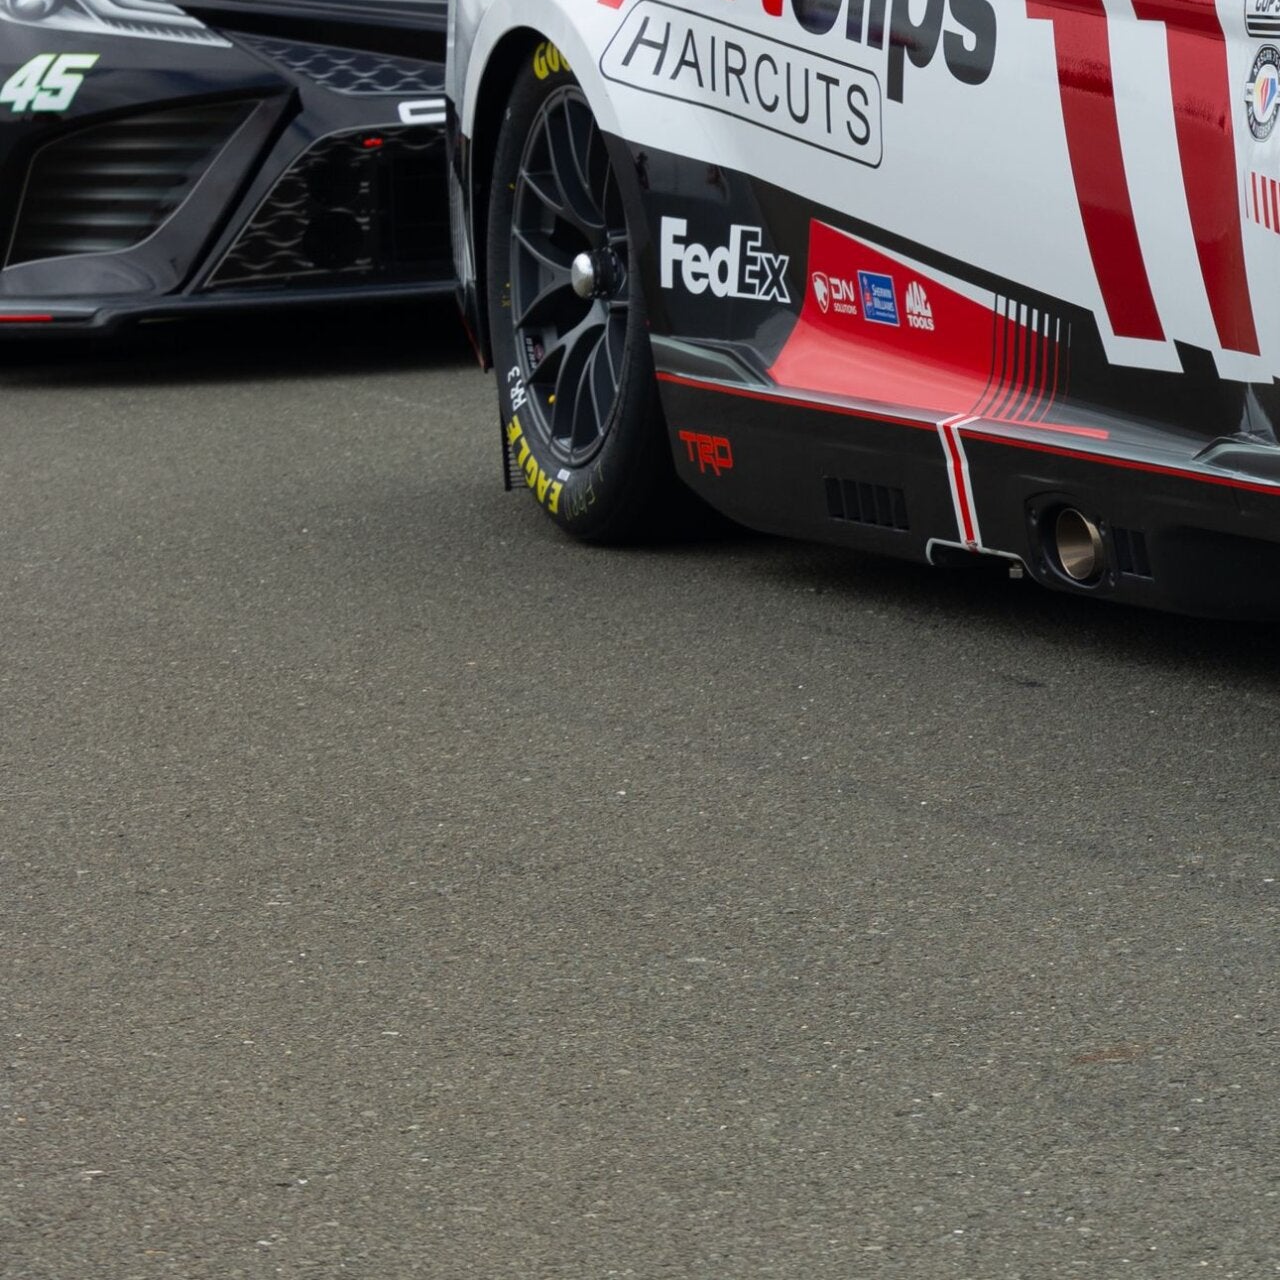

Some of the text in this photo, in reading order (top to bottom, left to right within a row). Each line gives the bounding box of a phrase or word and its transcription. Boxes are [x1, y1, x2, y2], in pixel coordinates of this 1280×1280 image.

[1, 54, 100, 113] 45
[621, 15, 872, 147] HAIRCUTS
[660, 216, 791, 304] FedEx
[829, 276, 855, 302] DN
[905, 280, 933, 318] MAC
[907, 314, 935, 331] TOOLS
[506, 413, 563, 515] EAGLE
[679, 429, 734, 477] TRD
